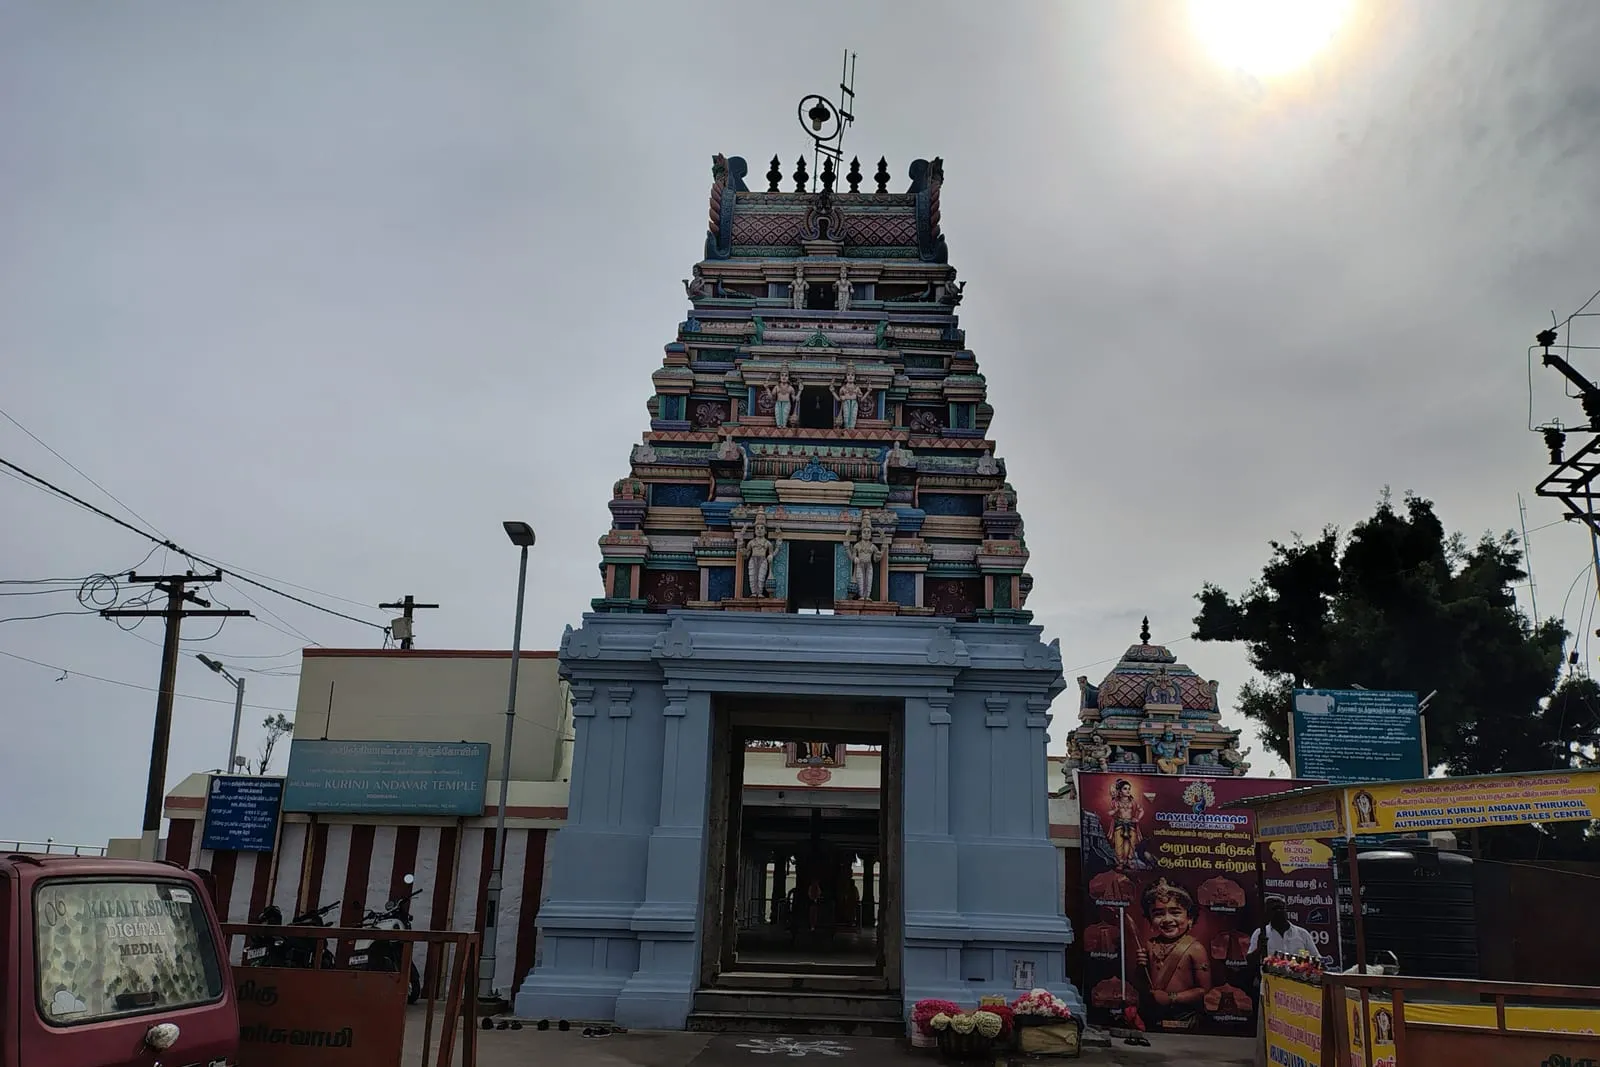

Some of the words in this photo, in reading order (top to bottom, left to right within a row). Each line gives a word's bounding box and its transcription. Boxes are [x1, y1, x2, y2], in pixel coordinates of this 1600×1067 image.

[324, 779, 369, 790] KURINJI
[374, 780, 428, 791] ANDAVAR
[431, 780, 478, 791] TEMPLE
[1396, 808, 1444, 818] ARULMIGU
[1446, 806, 1485, 815] KURINJI
[1487, 803, 1532, 812] ANDAVAR
[1156, 812, 1248, 824] MAYILVAHANAM
[1394, 817, 1454, 828] AUTHORIZED
[1456, 816, 1487, 825] POOJA
[1489, 813, 1519, 823] ITEMS
[1520, 811, 1551, 820] SALES
[1553, 808, 1592, 819] CENTRE
[1157, 856, 1212, 869] ஆன்மிக
[1289, 855, 1310, 863] 2025
[1265, 878, 1294, 888] வாகன
[1295, 878, 1317, 891] வசதி
[1287, 894, 1333, 906] தங்குமிடம்
[106, 921, 166, 938] DIGITAL
[118, 942, 163, 957] MEDIA
